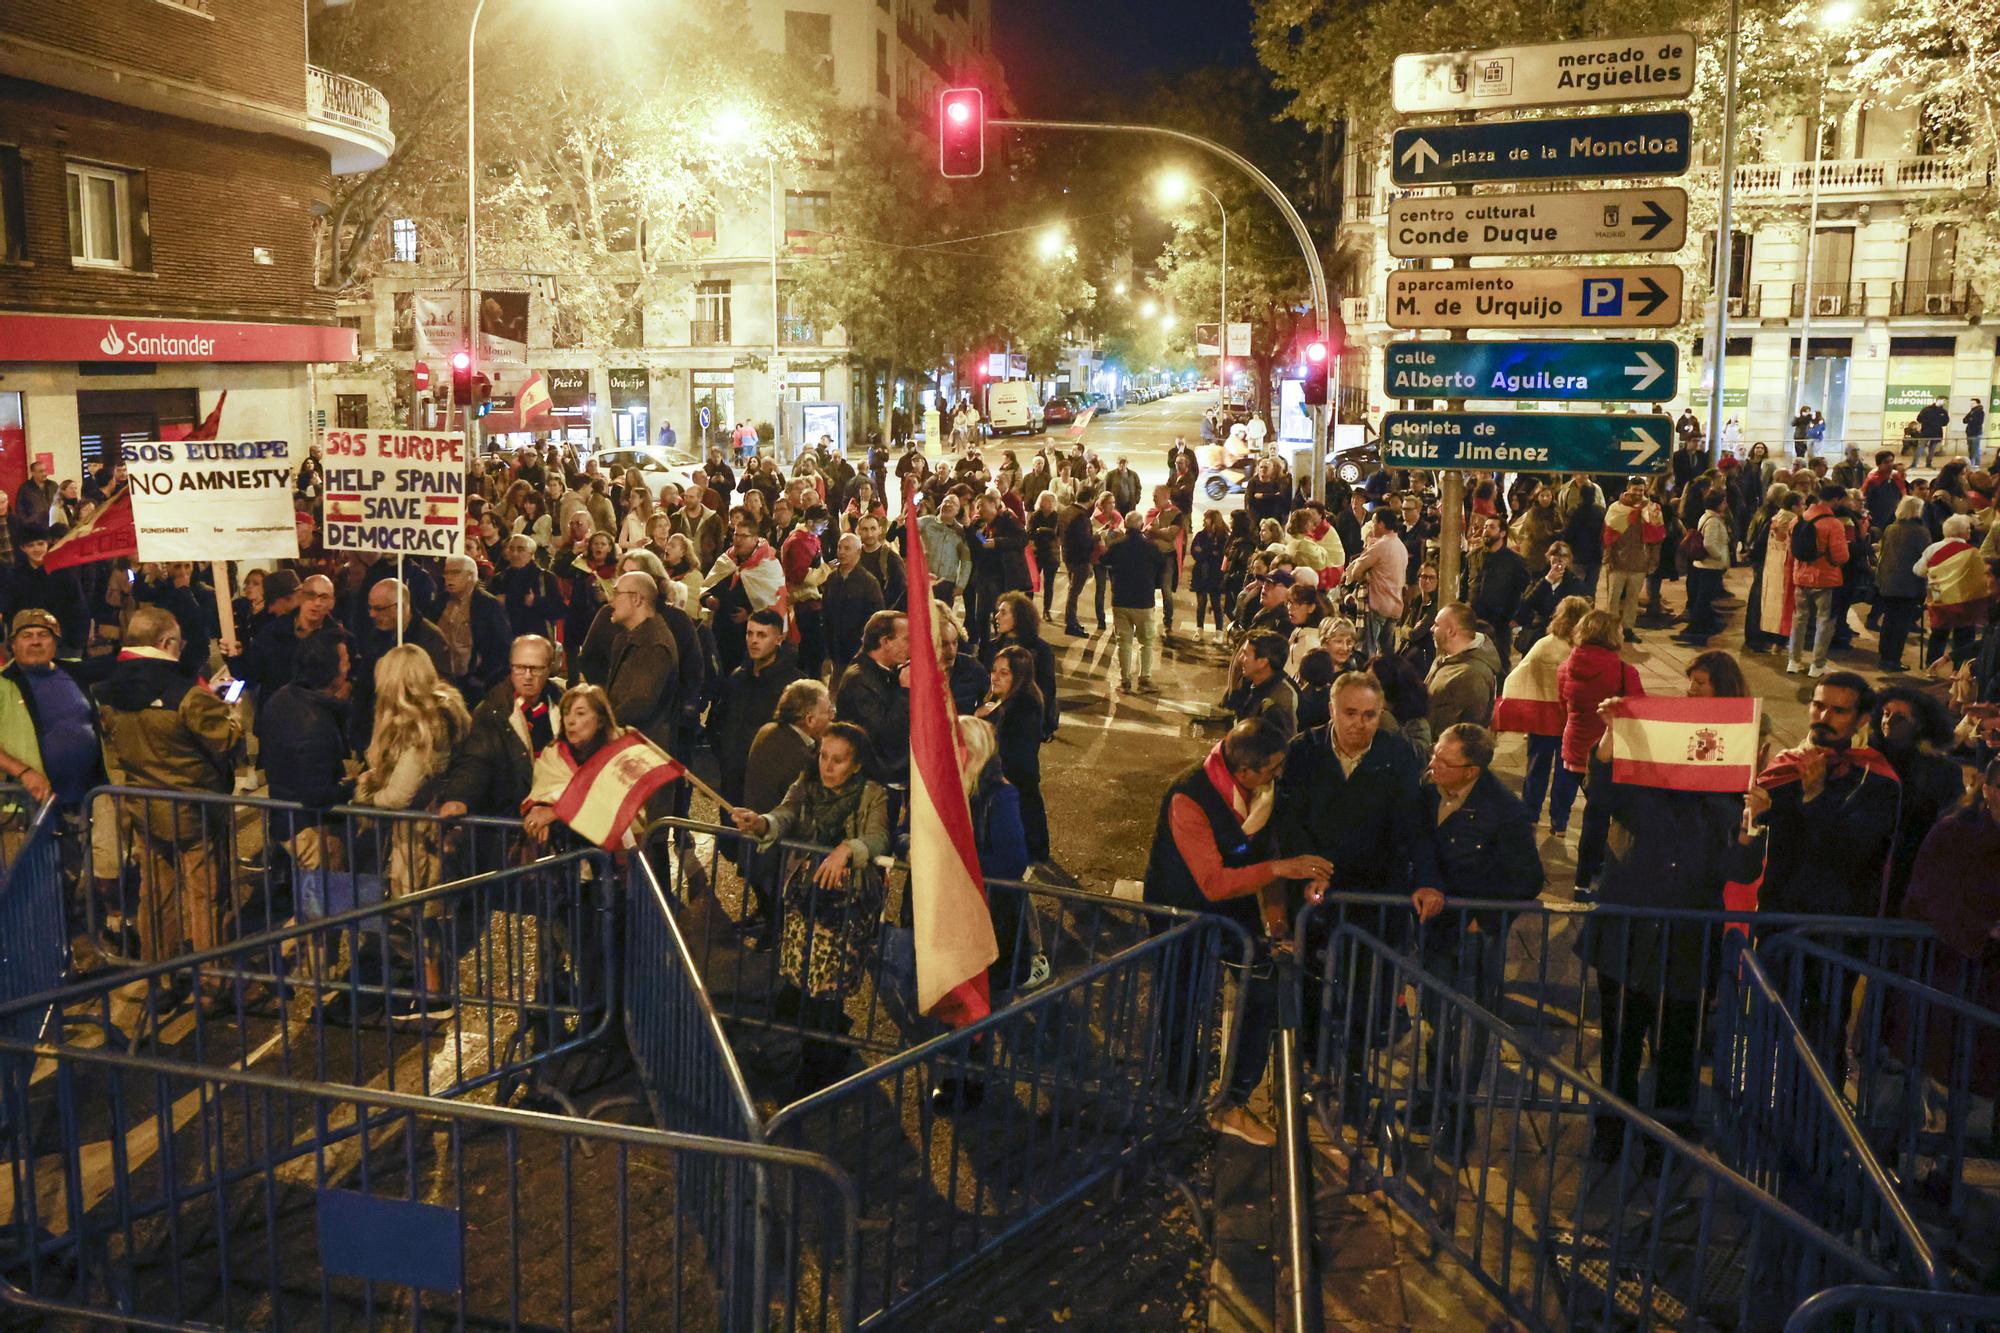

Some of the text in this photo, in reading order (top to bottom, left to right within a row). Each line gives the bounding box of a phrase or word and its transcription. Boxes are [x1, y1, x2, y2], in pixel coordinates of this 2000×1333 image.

[1557, 44, 1683, 68] mercado de
[1557, 62, 1682, 92] Argüelles
[1451, 135, 1679, 166] plaza de la Moncloa
[1400, 204, 1536, 222] centro cultural
[1399, 225, 1558, 245] Conde Duque
[1397, 278, 1514, 293] aparcamiento
[1396, 296, 1563, 319] M. de Urquijo
[1589, 281, 1615, 314] P
[127, 332, 216, 356] Santander
[1395, 351, 1436, 365] calle
[1394, 371, 1589, 392] Alberto Aguilera
[1901, 390, 1933, 398] LOCAL
[1391, 420, 1496, 438] glorieta de
[121, 440, 289, 463] SOS EUROPE
[326, 432, 464, 463] SOS EUROPE
[1391, 440, 1548, 462] Ruiz Jiménez
[128, 468, 290, 496] NO AMNESTY
[325, 469, 463, 494] HELP SPAIN
[364, 497, 421, 520] SAVE
[327, 523, 460, 554] DEMOCRACY
